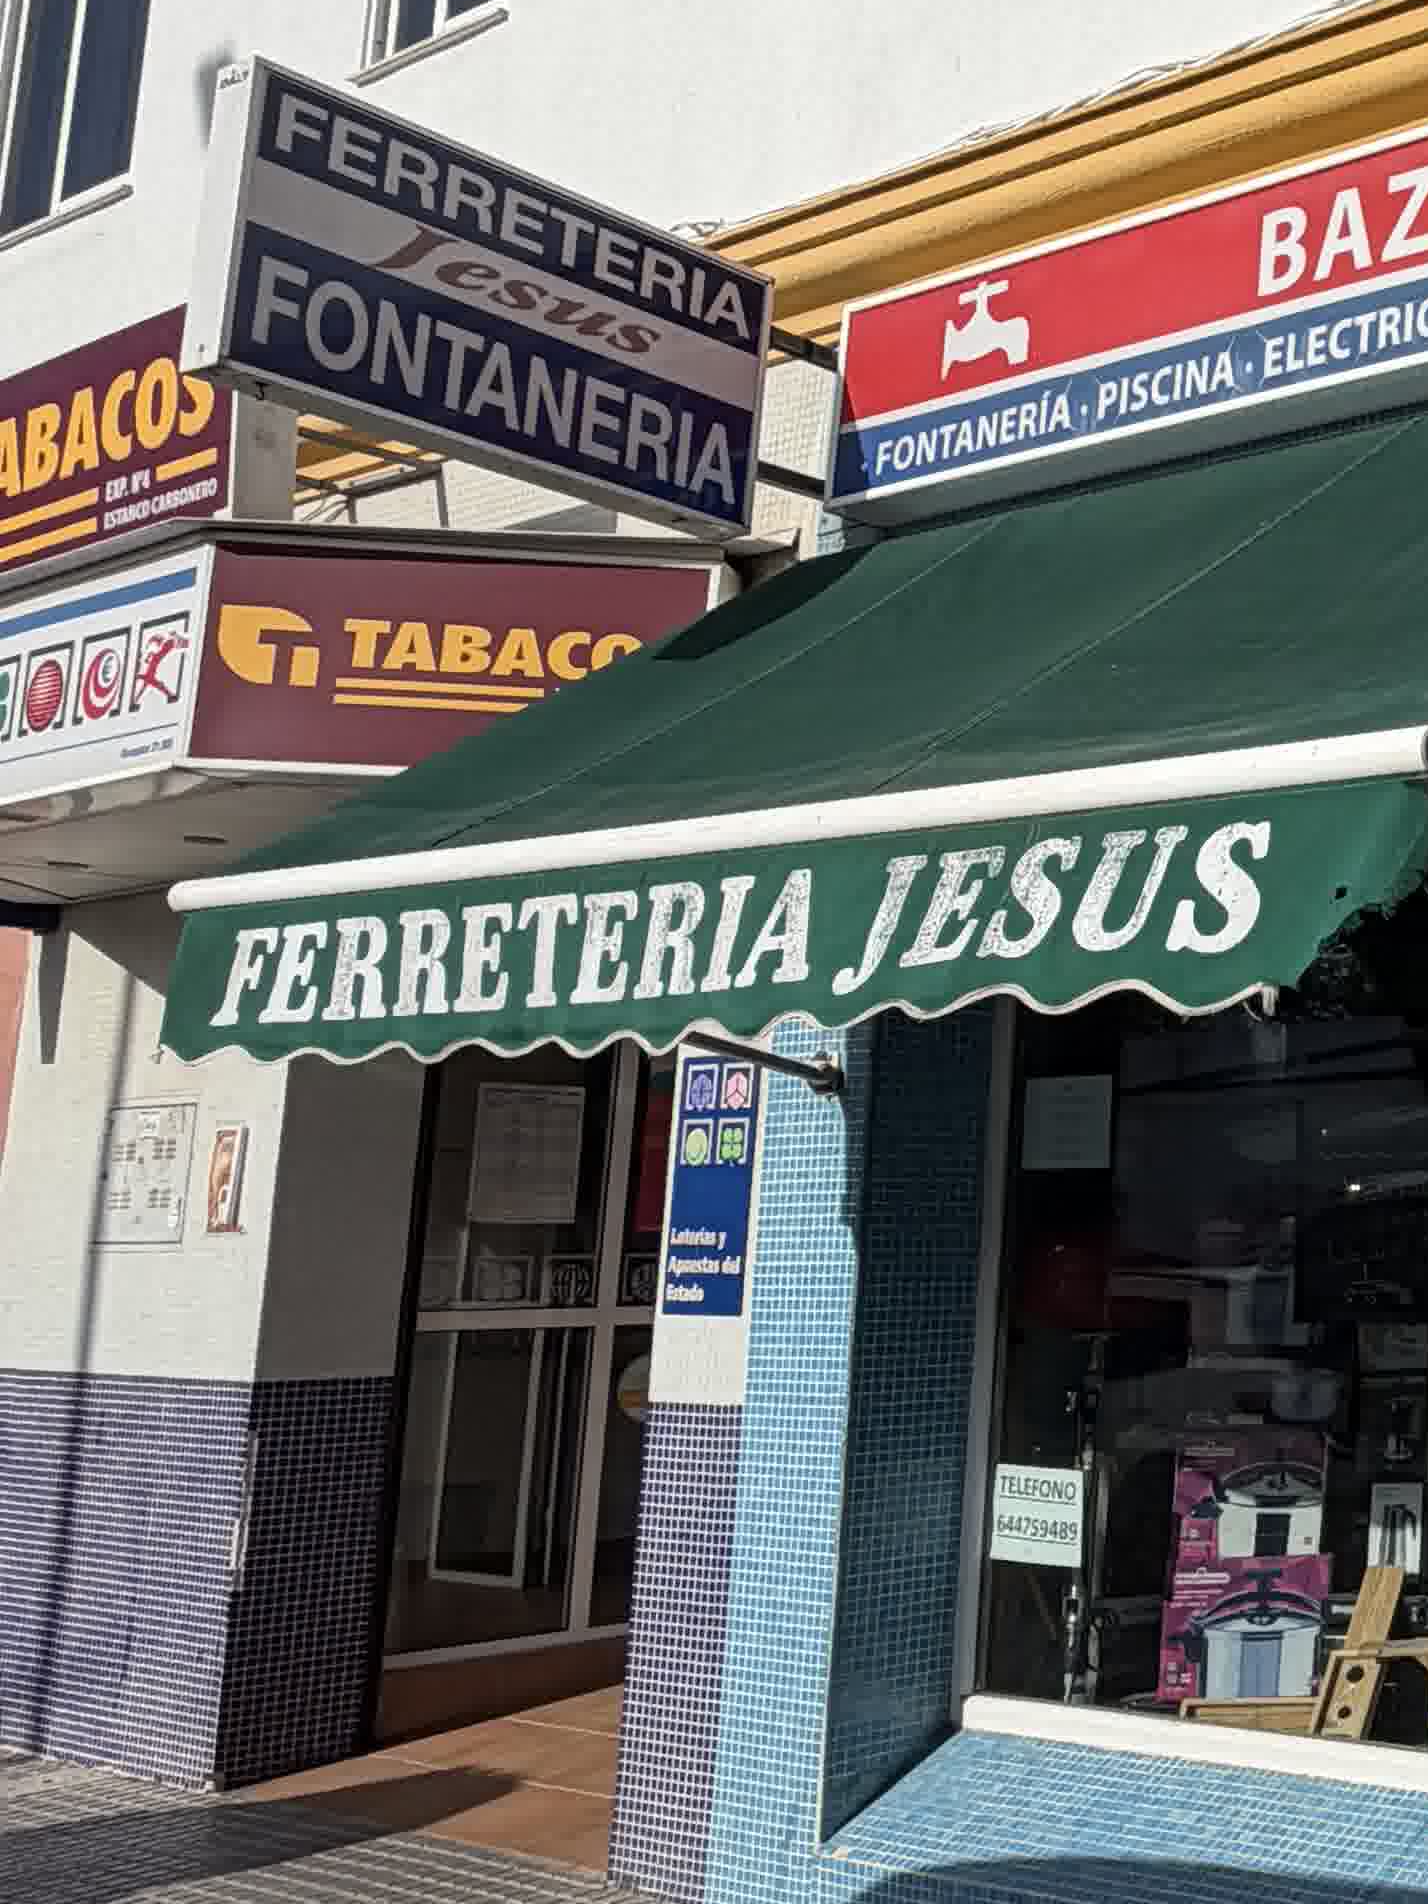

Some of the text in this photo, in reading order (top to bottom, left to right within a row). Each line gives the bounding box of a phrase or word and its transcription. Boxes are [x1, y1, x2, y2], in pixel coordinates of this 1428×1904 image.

[276, 93, 751, 339] FERRETERIA
[369, 224, 663, 355] Jesus
[251, 256, 736, 505] FONTANERIA
[875, 390, 1072, 475] FONTANERÍA
[1098, 351, 1235, 419] PISCINA
[209, 821, 1272, 1027] FERRETERIA JESUS
[665, 1283, 705, 1301] Estado
[1000, 1475, 1077, 1501] TELEFONO
